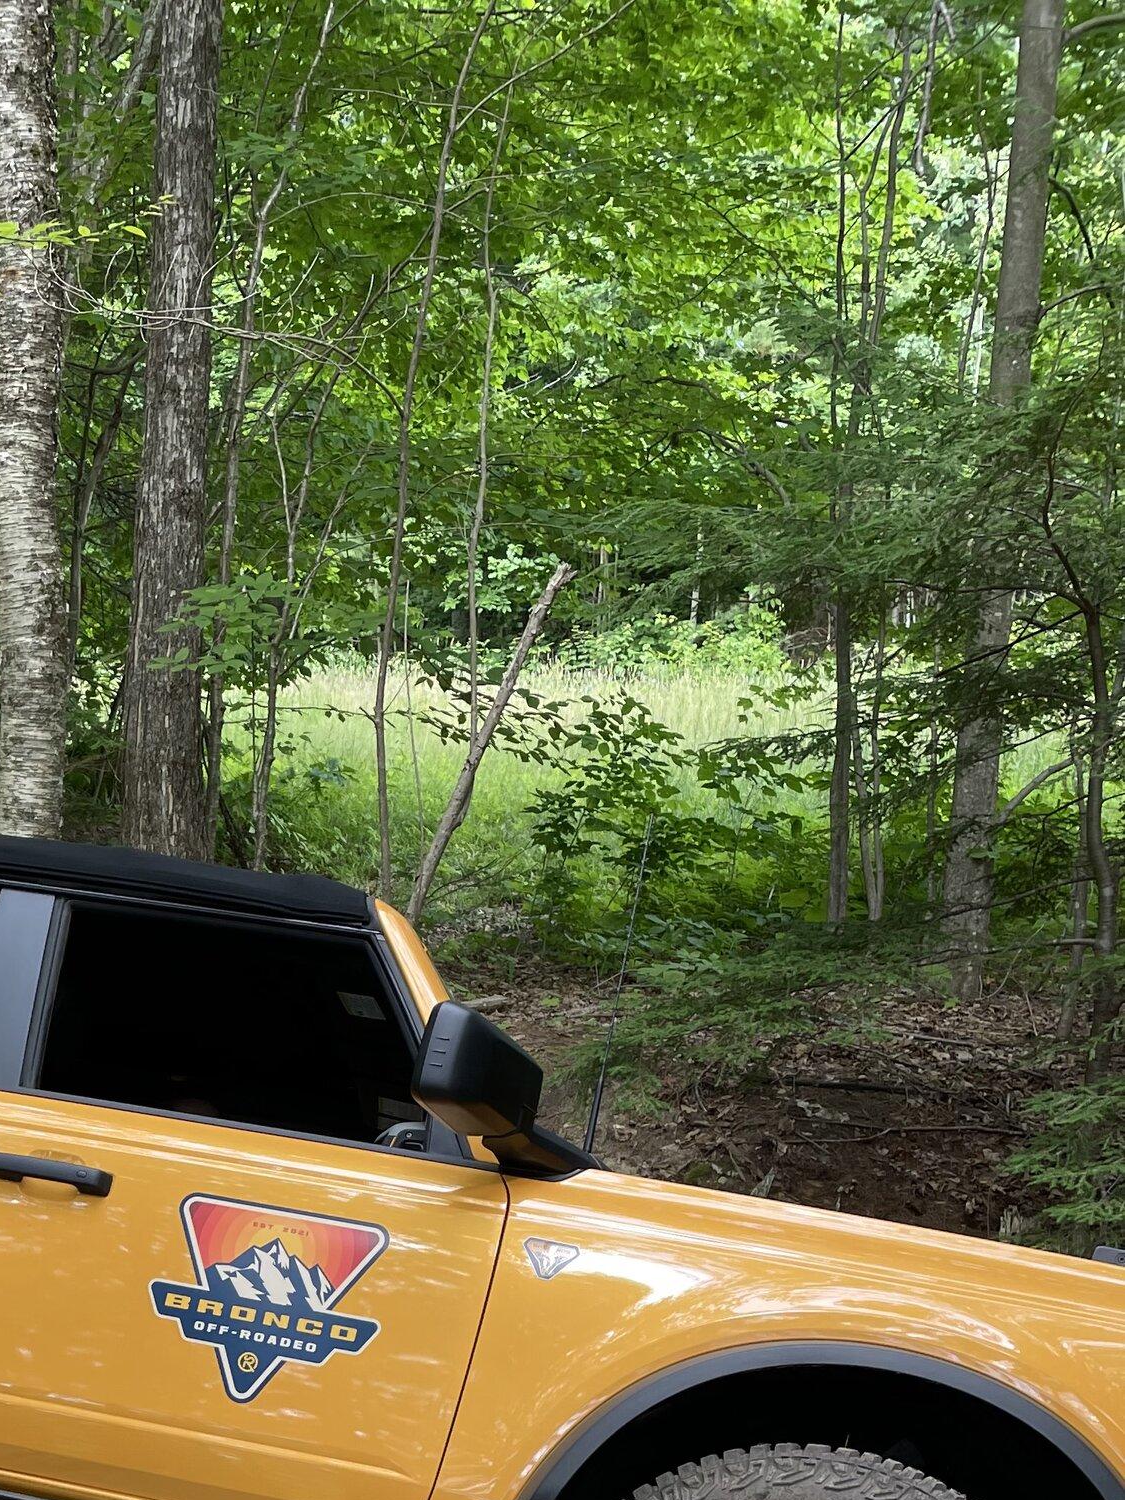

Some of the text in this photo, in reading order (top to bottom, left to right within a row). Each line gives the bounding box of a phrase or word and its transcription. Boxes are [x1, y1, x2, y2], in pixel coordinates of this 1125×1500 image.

[282, 1226, 309, 1237] 2021
[164, 1292, 358, 1343] BRONCO
[194, 1321, 317, 1353] OFF-ROADEO
